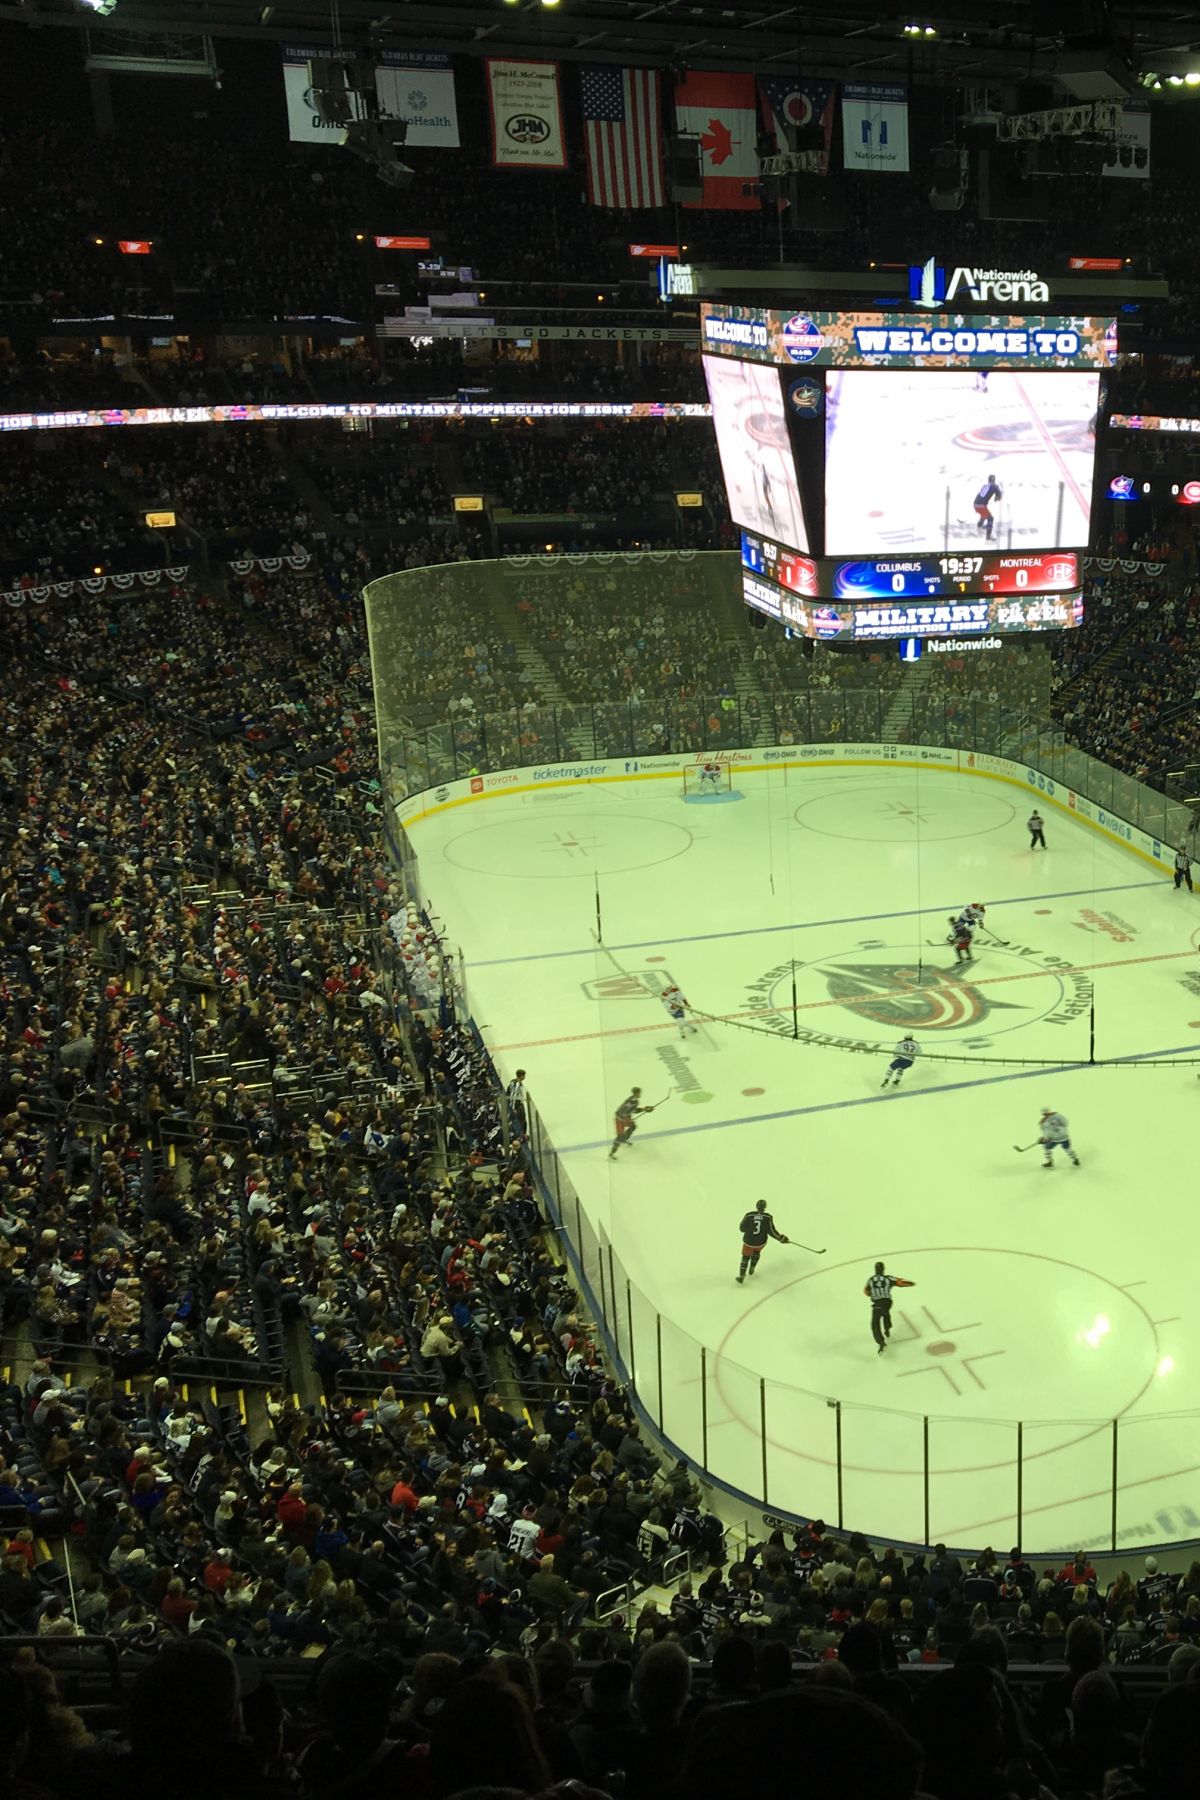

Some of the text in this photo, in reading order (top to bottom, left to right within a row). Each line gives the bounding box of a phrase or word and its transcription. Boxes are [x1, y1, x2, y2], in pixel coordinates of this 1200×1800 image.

[512, 119, 544, 135] JHM
[855, 151, 897, 160] Nationwide
[973, 269, 1039, 281] Nationwide
[945, 268, 1049, 302] Arena
[523, 327, 550, 338] GO
[563, 328, 662, 339] JACKETS
[705, 319, 752, 344] WELCOME
[857, 330, 1078, 353] WELCOME TO
[261, 404, 633, 417] WELCOME TO MILITARY APPRECIATION NIGHT
[37, 413, 88, 427] NIGHT
[1143, 483, 1150, 493] 0
[1172, 485, 1179, 495] 0
[876, 562, 922, 572] COLUMBUS
[940, 557, 984, 575] 19:37
[1000, 558, 1043, 568] MONTREAL
[892, 573, 905, 592] 0
[1016, 569, 1028, 588] 0
[960, 582, 966, 592] 1
[989, 582, 995, 590] 1
[855, 605, 988, 628] MILITARY
[1026, 607, 1042, 623] &
[856, 621, 989, 637] APPRECIATION NIGHT
[928, 638, 1002, 652] Nationwide
[695, 751, 752, 763] Tim Hortons
[533, 763, 607, 780] ticketmaster
[641, 761, 687, 771] Nationwide
[486, 774, 519, 787] TOYOTA
[744, 960, 806, 993] Arena
[753, 1220, 761, 1235] 3
